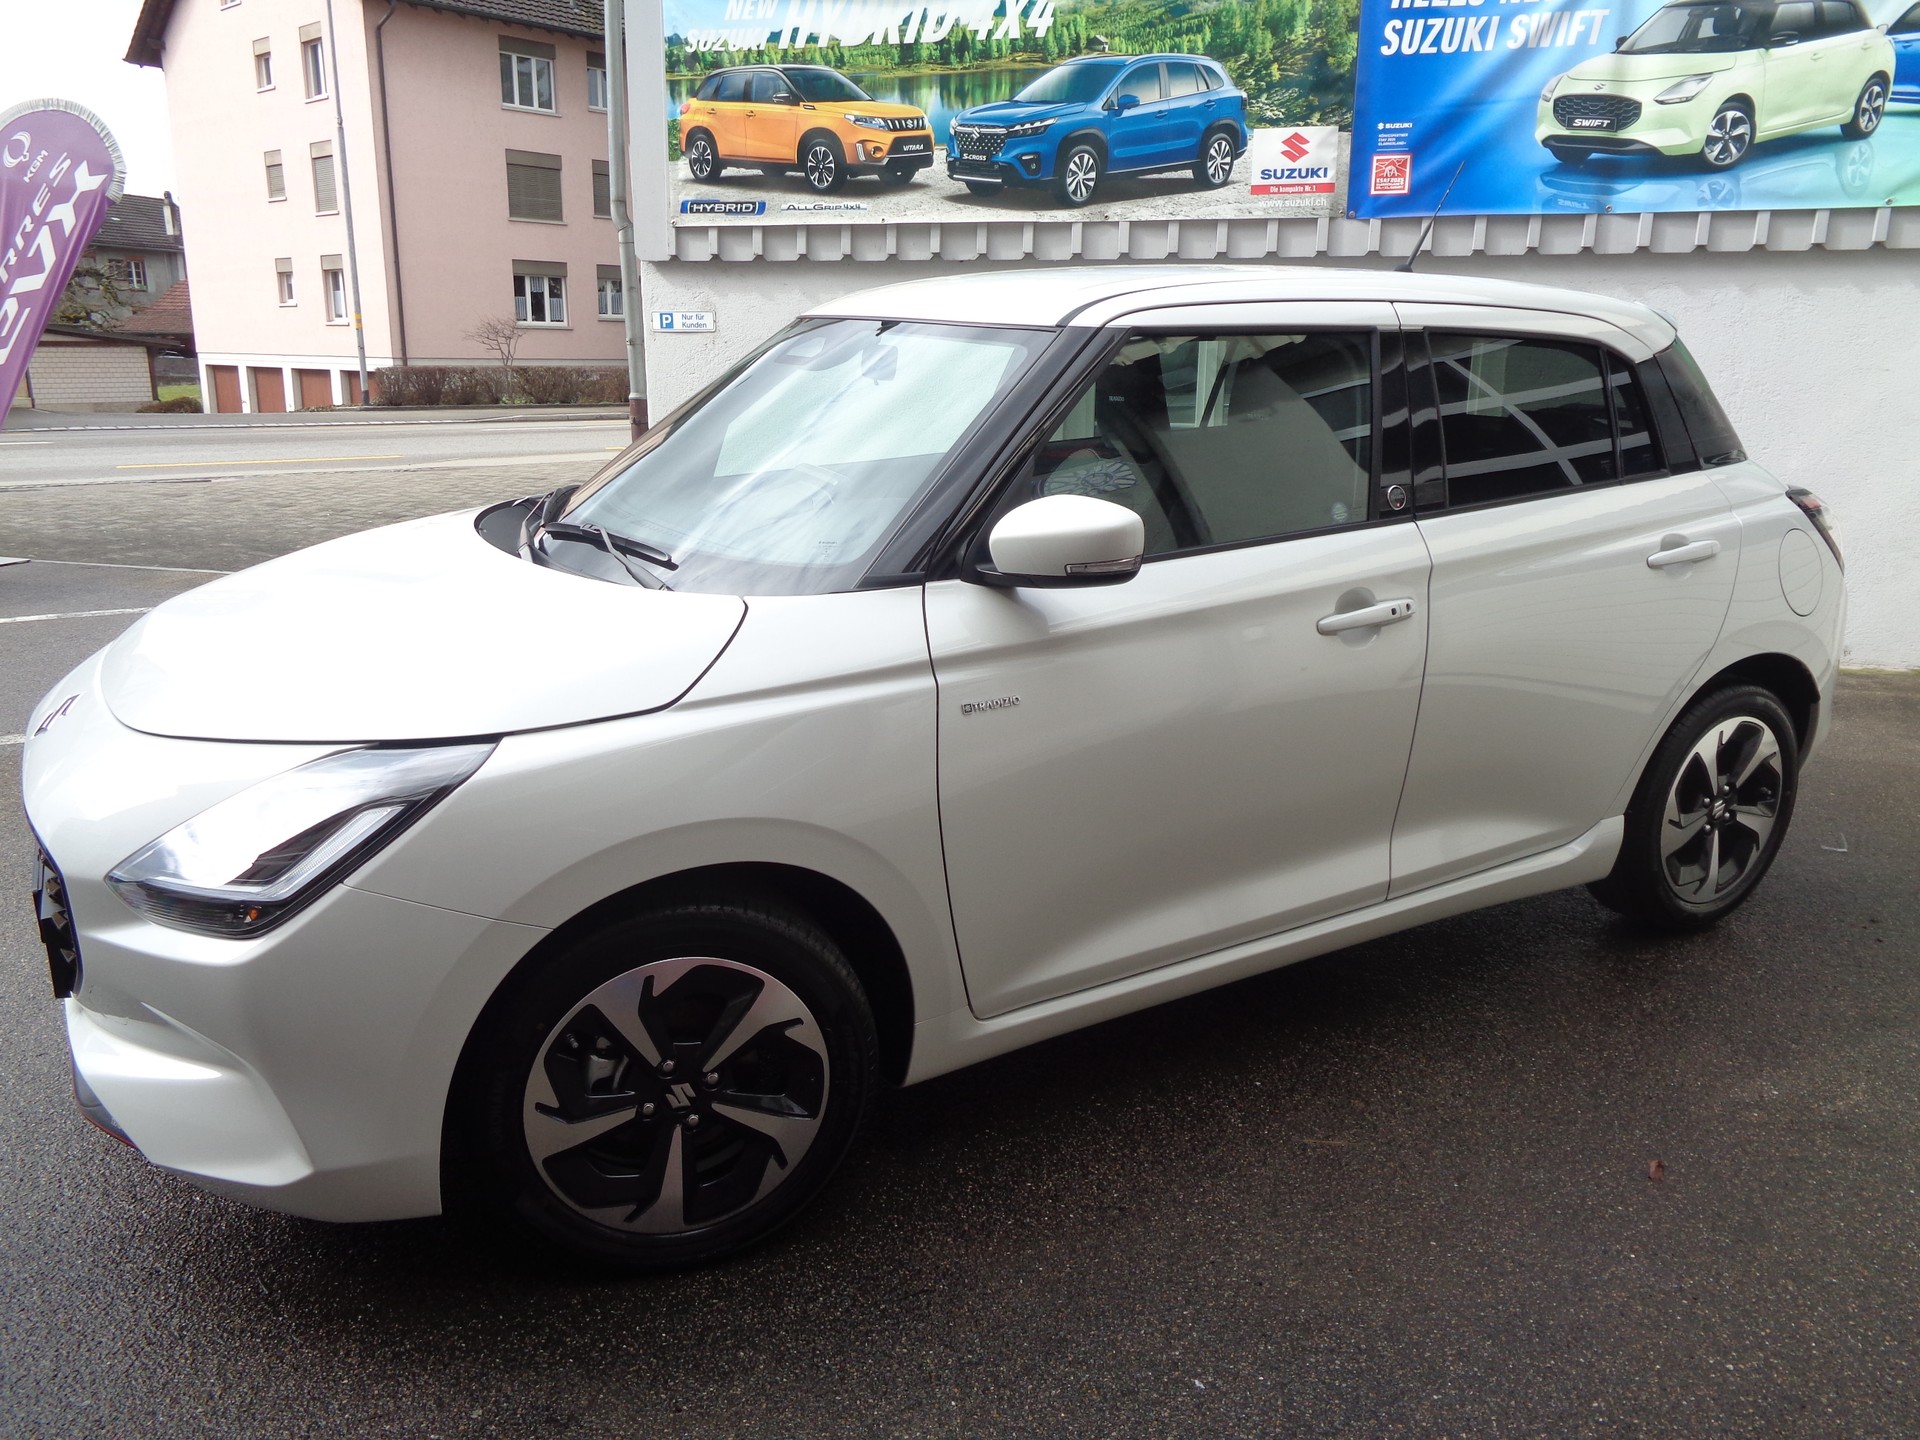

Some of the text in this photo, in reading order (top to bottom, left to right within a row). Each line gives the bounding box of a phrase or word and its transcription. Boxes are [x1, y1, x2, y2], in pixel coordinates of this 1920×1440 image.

[724, 0, 777, 20] NEW
[778, 0, 1055, 49] HYBRID 4X4
[1380, 8, 1610, 56] SUZUKI SWIFT
[685, 28, 772, 53] SUZUKI
[1572, 118, 1611, 127] SWIFT
[962, 153, 987, 161] S-CROSS
[23, 149, 48, 183] KGM
[1260, 167, 1328, 180] SUZUKI
[1279, 185, 1304, 193] kompakte
[692, 202, 755, 213] HYBRID
[1258, 197, 1327, 208] www.suzuki.ch
